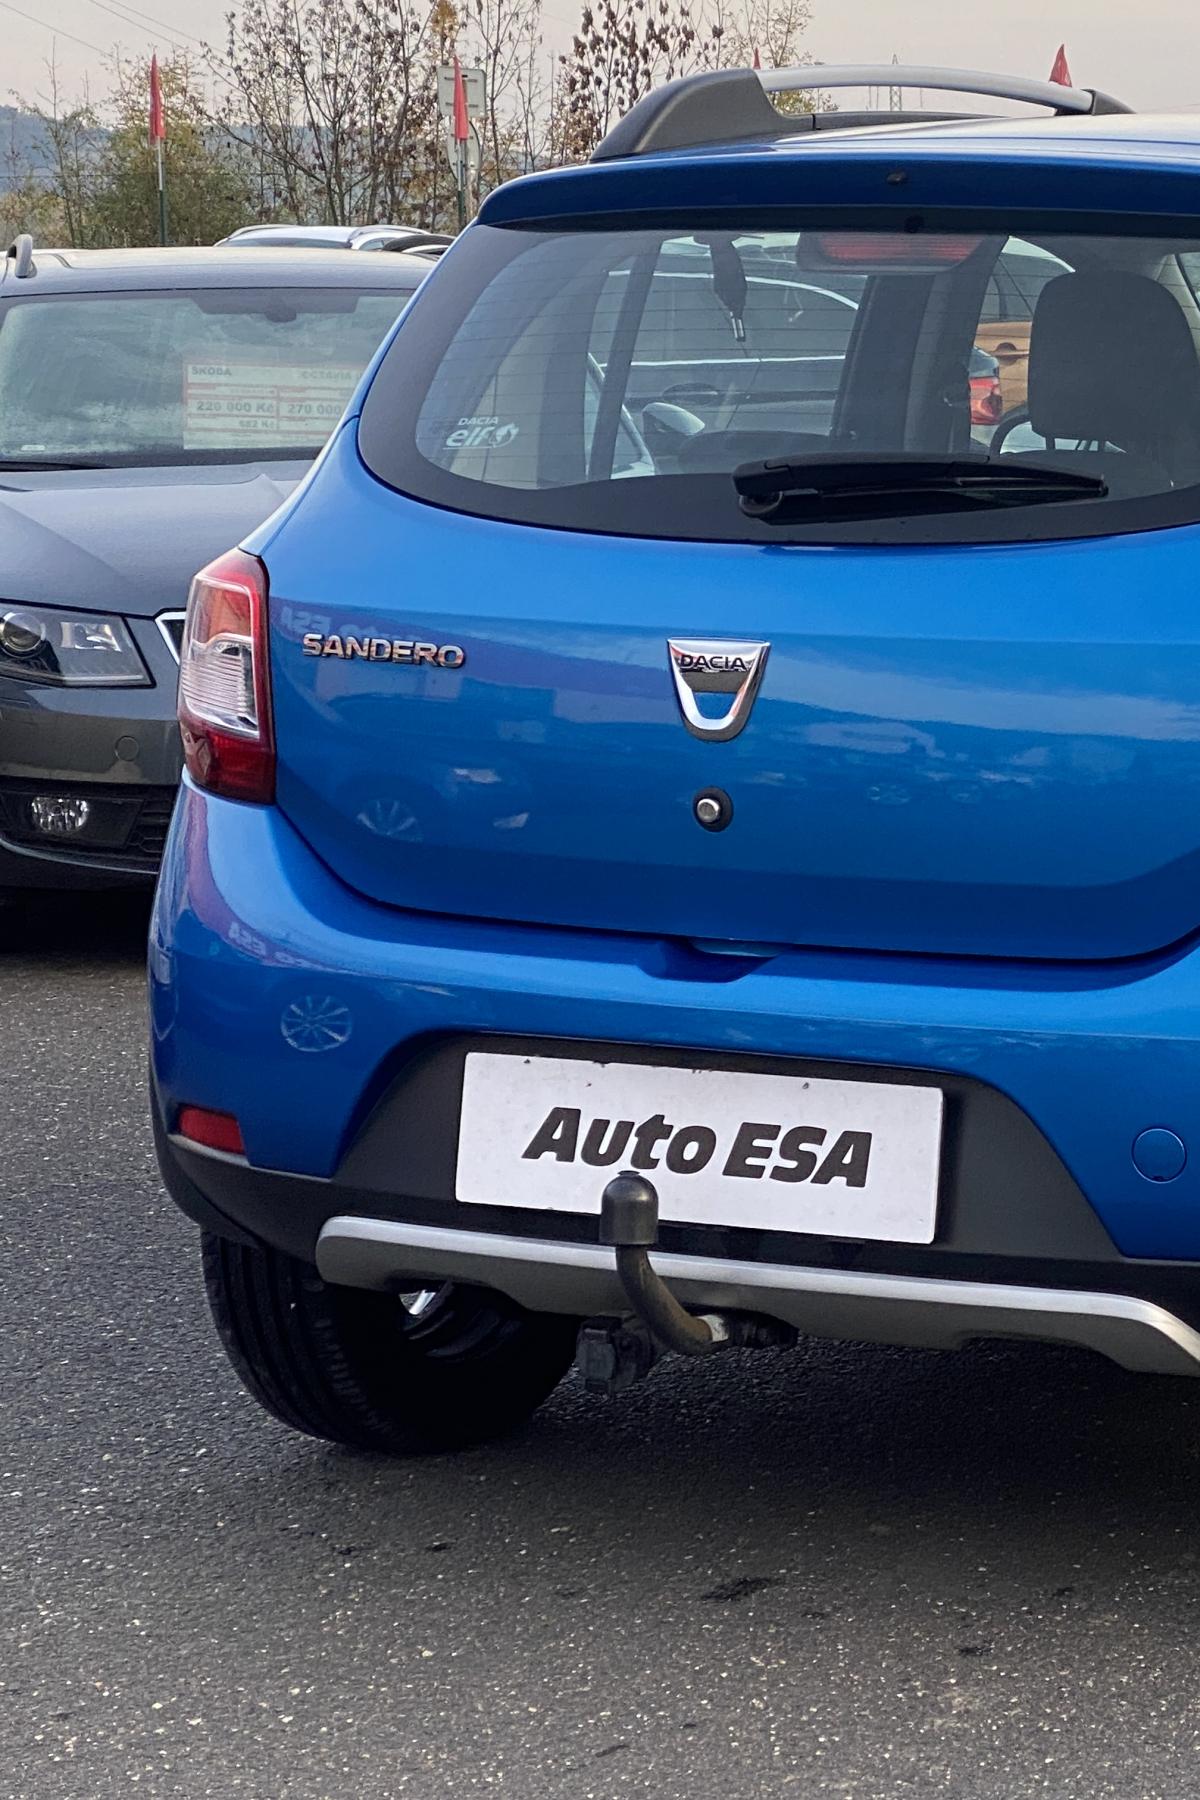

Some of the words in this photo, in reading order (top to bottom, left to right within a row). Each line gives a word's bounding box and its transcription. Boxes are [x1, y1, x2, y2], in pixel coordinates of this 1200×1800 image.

[458, 416, 499, 426] DACIA
[445, 426, 496, 447] elf
[302, 633, 466, 669] SANDERO
[680, 654, 748, 671] DACIA
[521, 1107, 717, 1175] Auto
[722, 1121, 873, 1189] ESA
